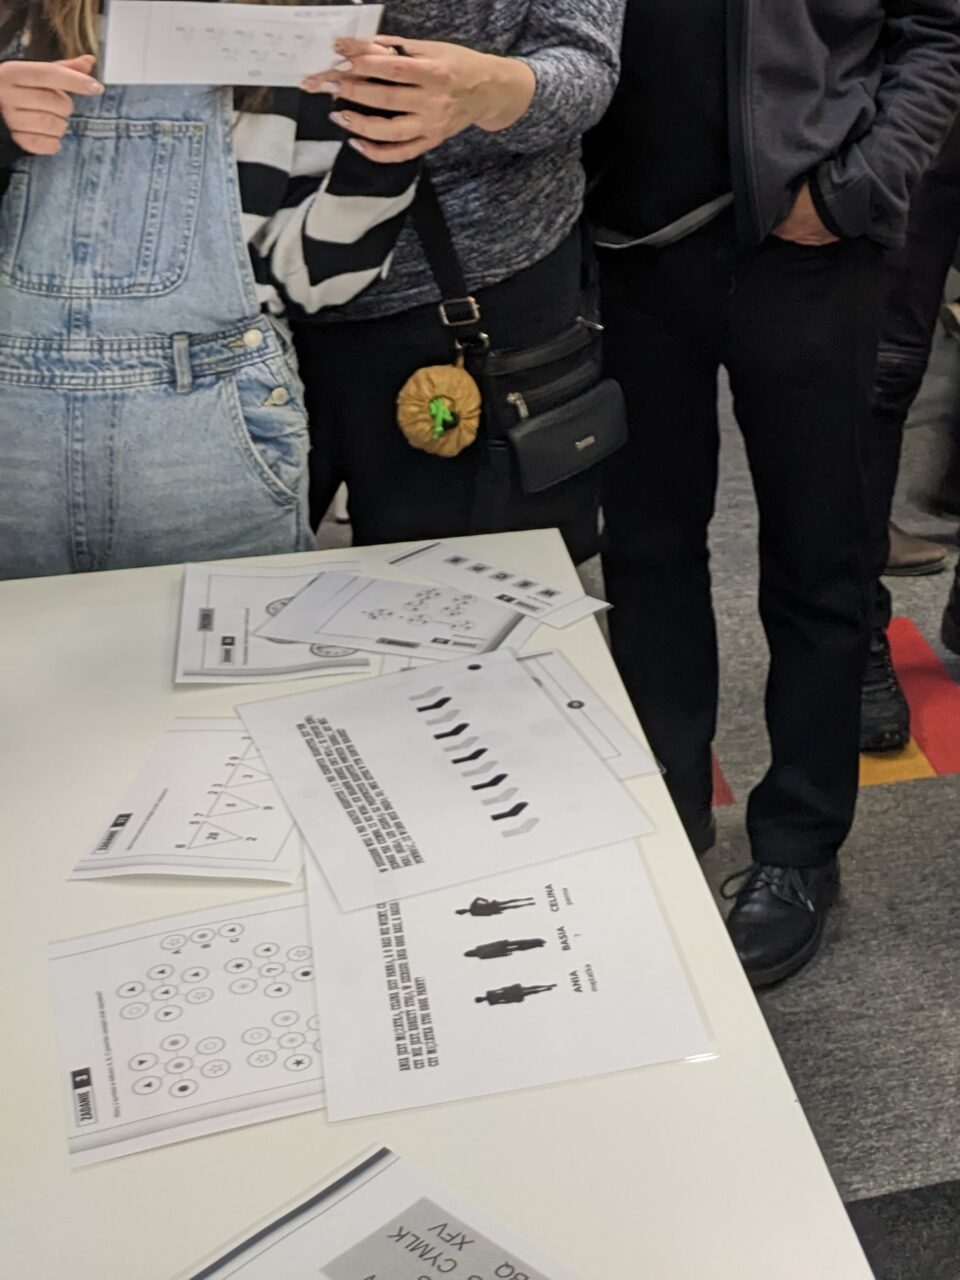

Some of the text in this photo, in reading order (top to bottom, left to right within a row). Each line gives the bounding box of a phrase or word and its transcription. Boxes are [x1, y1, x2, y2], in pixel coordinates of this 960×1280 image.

[544, 884, 560, 912] CELINA
[556, 926, 571, 951] BASIA
[569, 970, 584, 993] ANIA
[78, 1090, 93, 1122] ZADANIE
[387, 1226, 458, 1274] CYMLK
[427, 1222, 475, 1251] XFV
